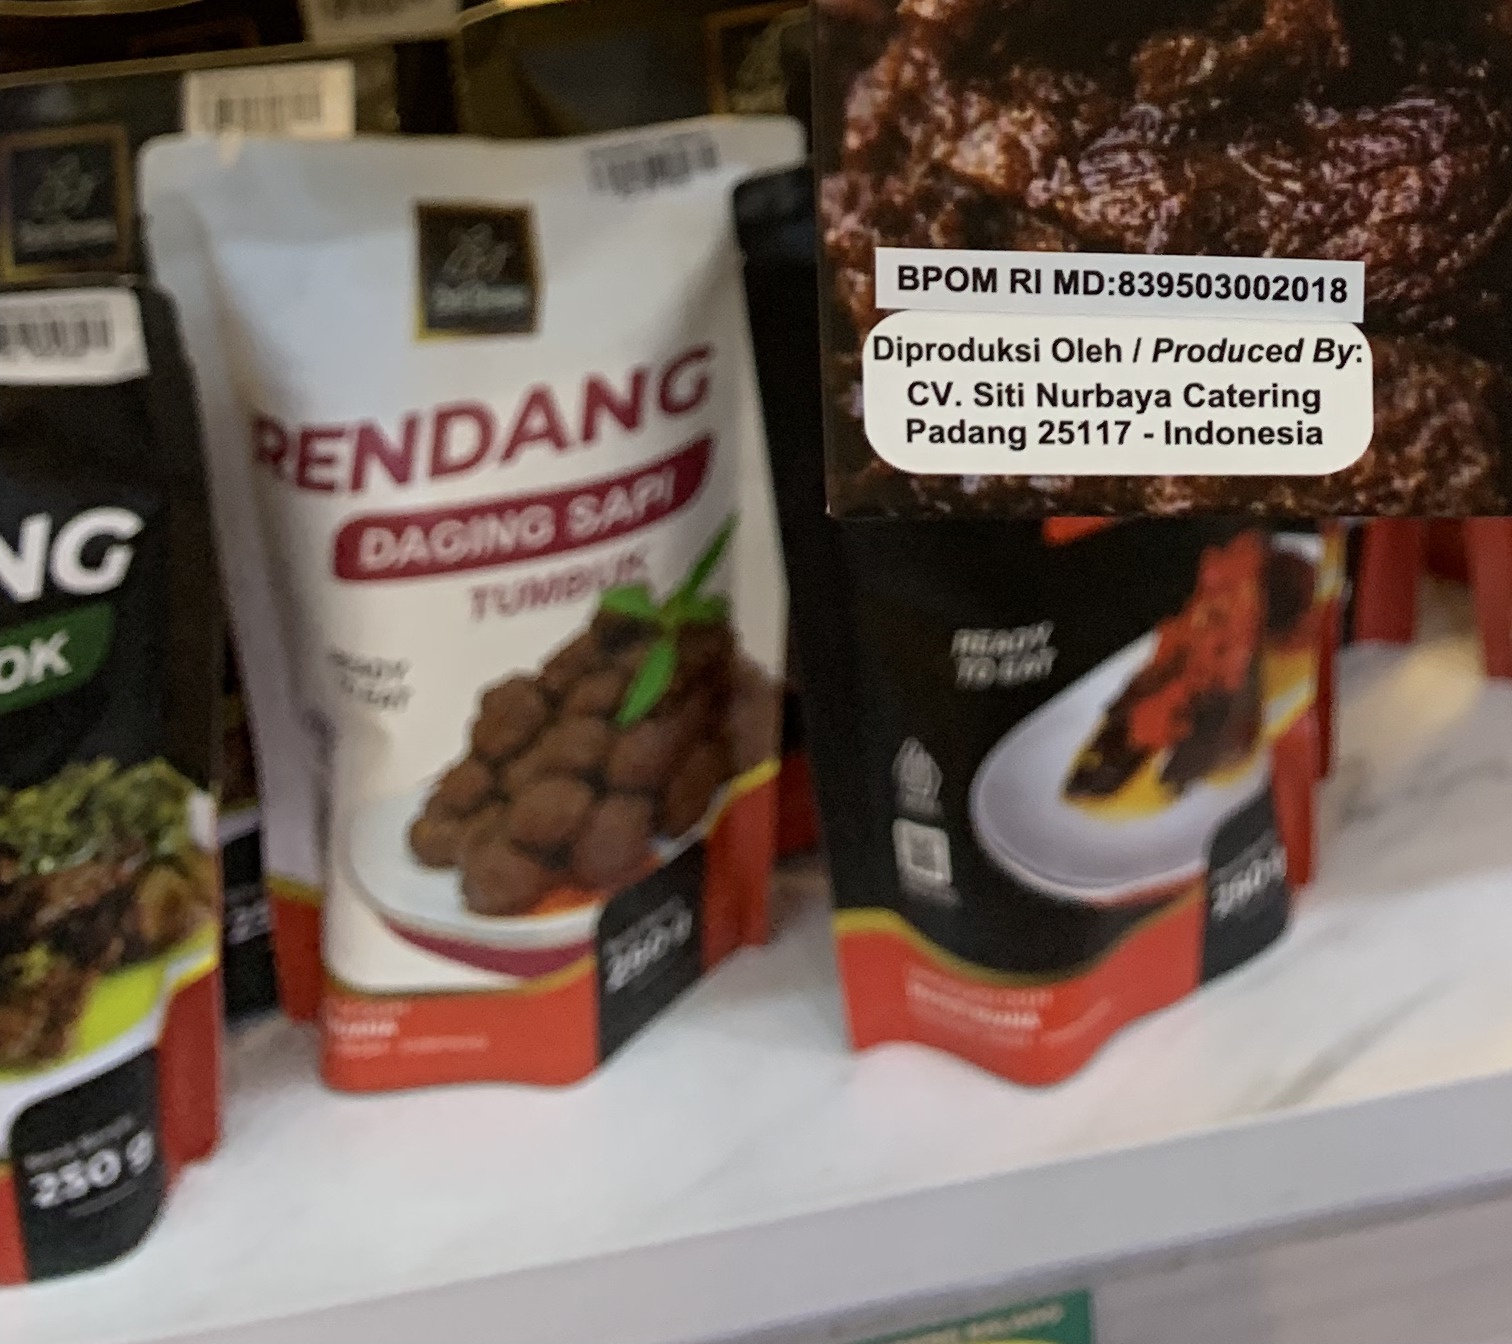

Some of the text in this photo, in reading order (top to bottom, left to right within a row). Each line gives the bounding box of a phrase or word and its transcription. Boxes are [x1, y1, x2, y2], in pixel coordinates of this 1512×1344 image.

[898, 265, 1348, 303] BPOM RI MD:839503002018
[873, 336, 1041, 367] Diproduksi
[1051, 336, 1123, 363] Oleh
[1152, 339, 1304, 363] Produced
[1313, 339, 1363, 369] By:
[907, 382, 1322, 415] CV. Siti Nurbaya Catering
[250, 344, 715, 495] RENDANG
[906, 419, 1027, 450] Padang
[1038, 420, 1132, 446] 25117
[1165, 421, 1324, 446] Indonesia
